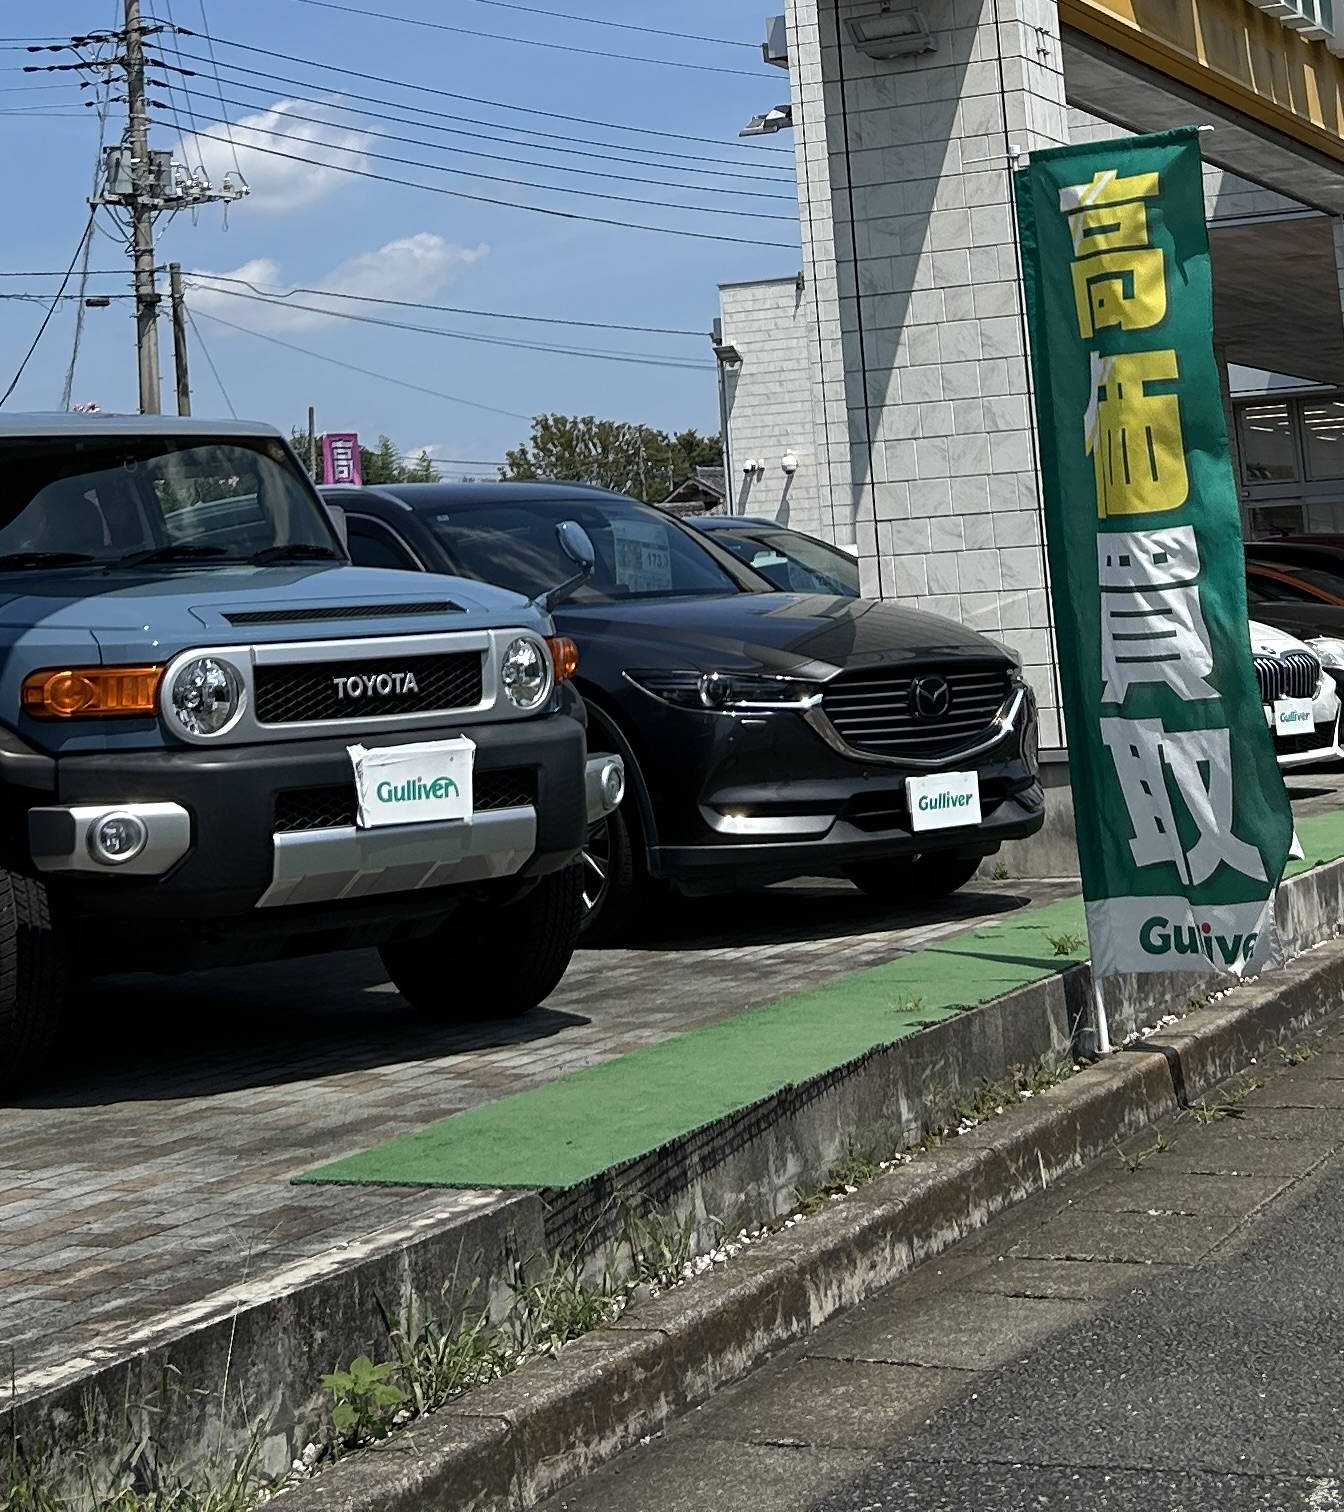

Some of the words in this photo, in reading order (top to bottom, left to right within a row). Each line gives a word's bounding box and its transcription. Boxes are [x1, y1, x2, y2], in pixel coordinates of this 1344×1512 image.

[1058, 169, 1269, 886] 高価買取
[333, 671, 419, 699] TOYOTA
[1280, 709, 1311, 723] Gulliver
[376, 775, 460, 804] Gulliver
[918, 789, 974, 812] Gulliver
